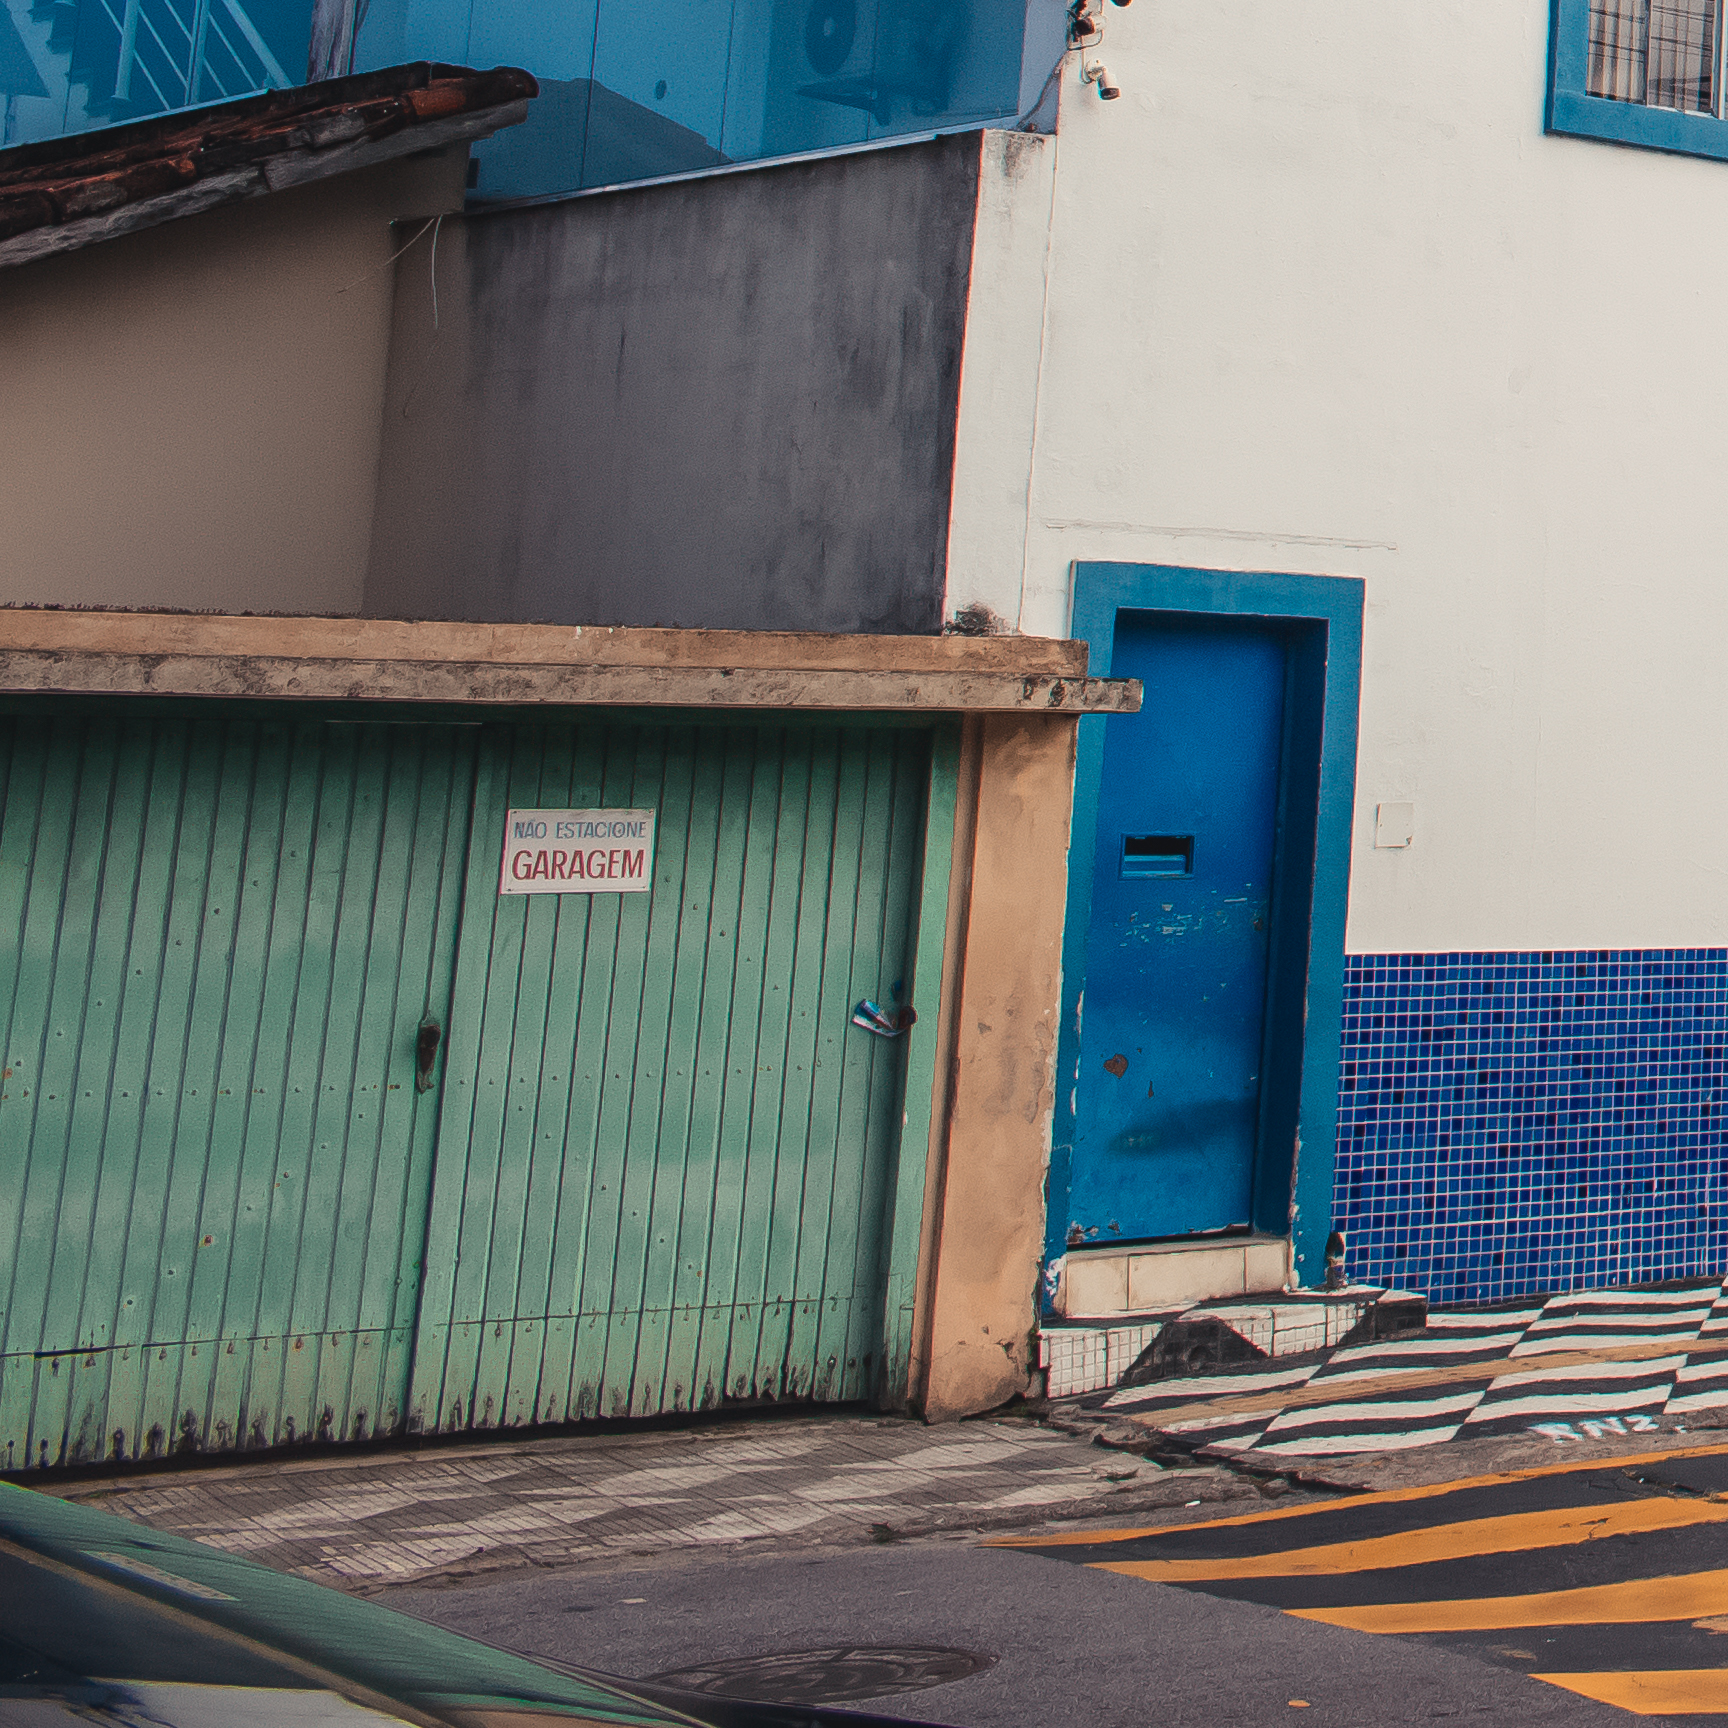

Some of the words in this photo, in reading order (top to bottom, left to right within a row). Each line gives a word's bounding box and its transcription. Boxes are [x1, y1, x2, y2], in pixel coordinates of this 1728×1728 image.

[513, 819, 547, 839] NÃO
[555, 821, 647, 839] ESTACIONE
[511, 848, 645, 881] GARAGEM
